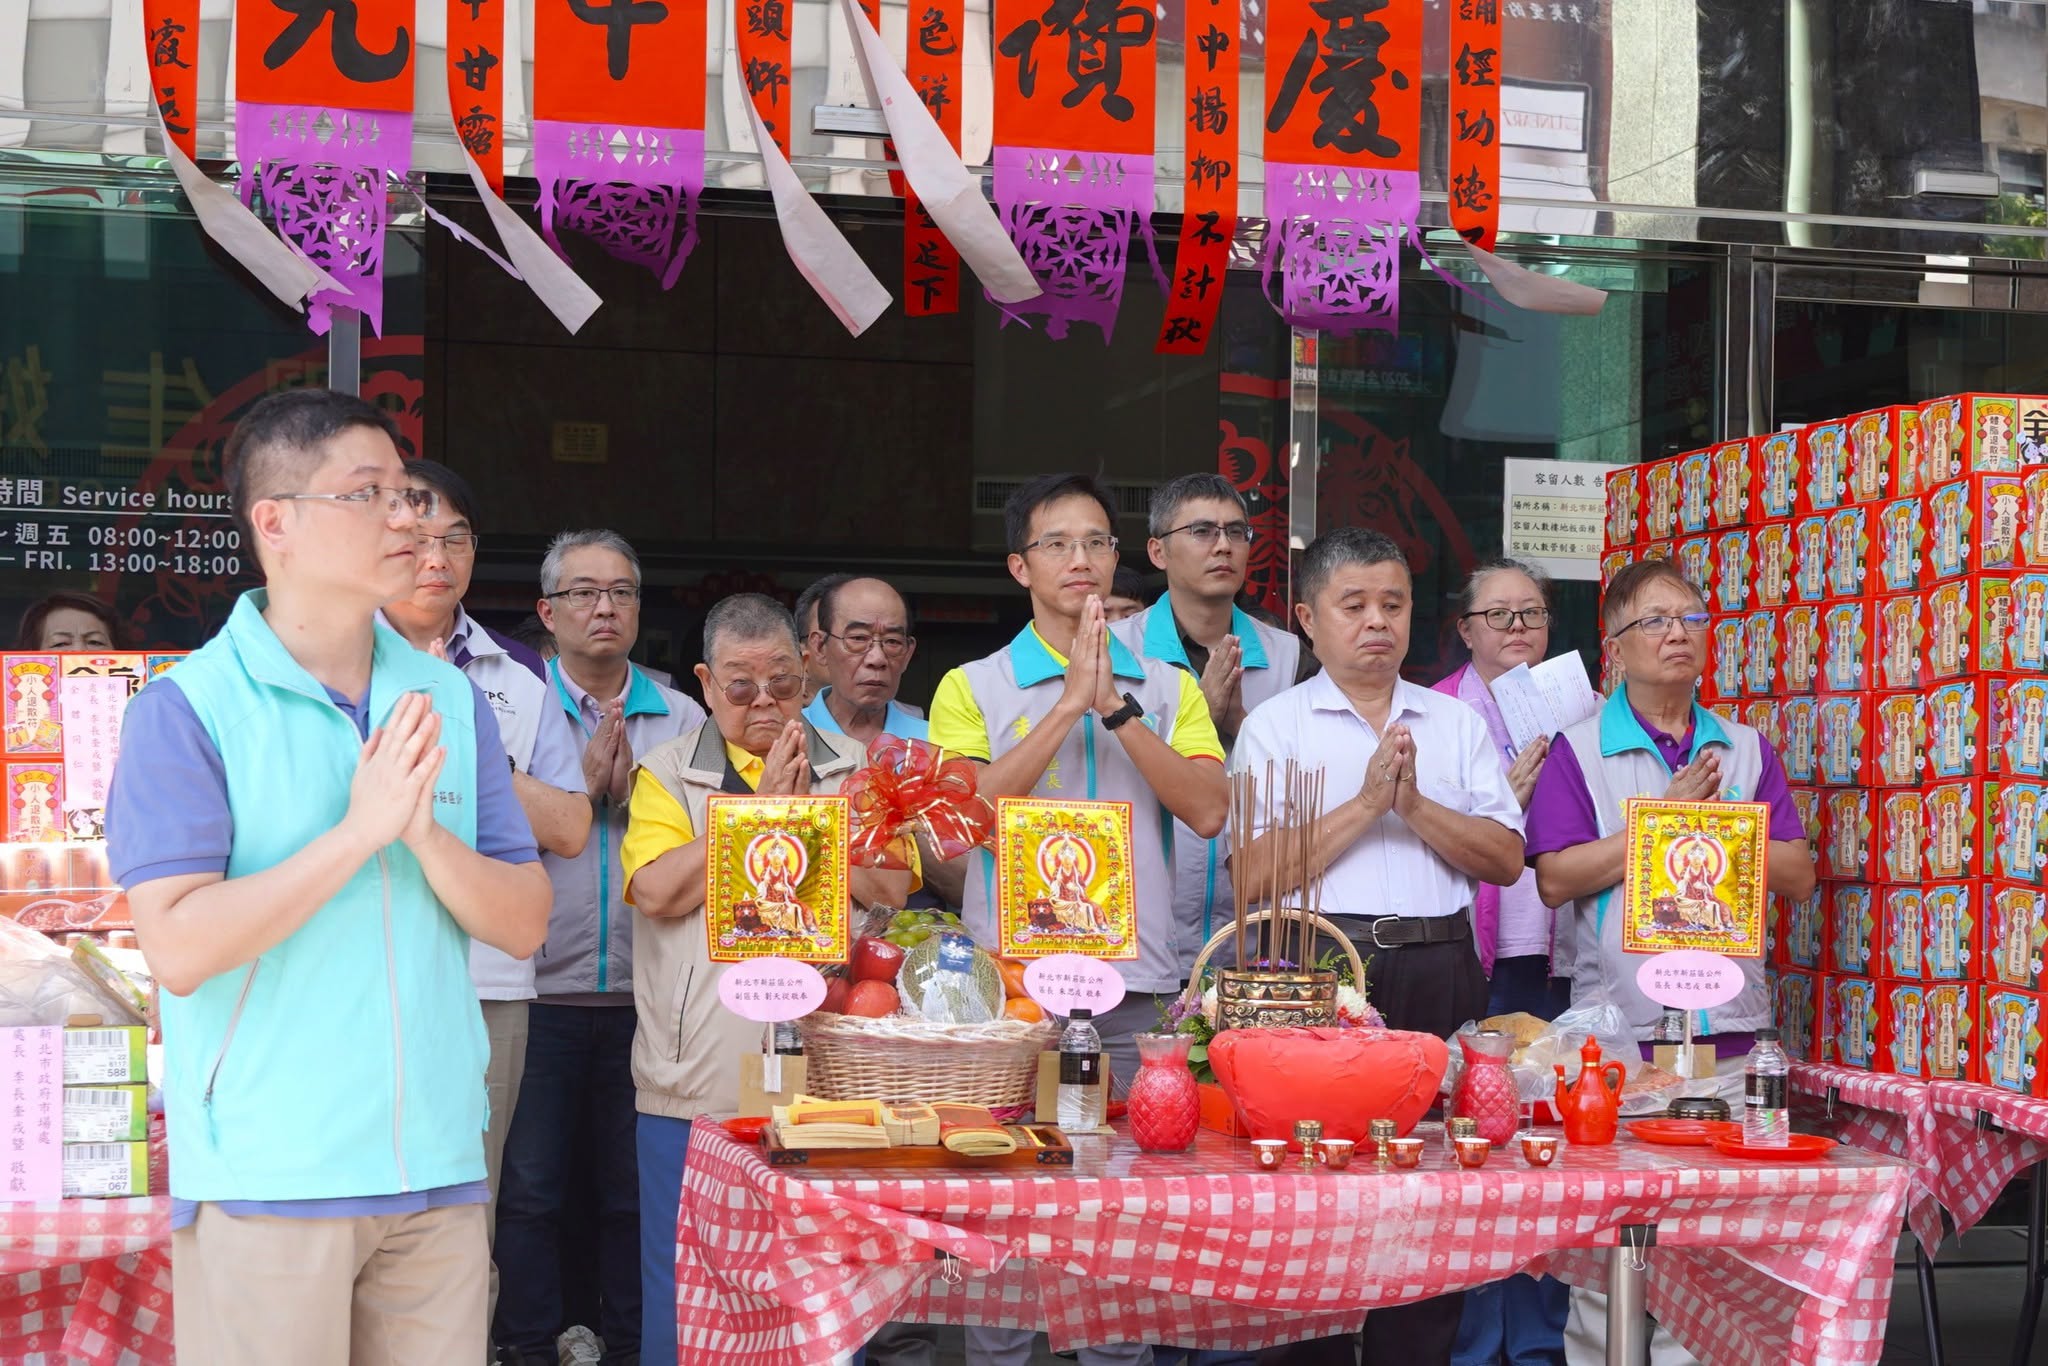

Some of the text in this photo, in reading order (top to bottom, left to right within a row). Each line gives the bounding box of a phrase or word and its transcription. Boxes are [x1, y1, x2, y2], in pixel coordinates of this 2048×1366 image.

[1535, 473, 1585, 487] 容留人數
[63, 486, 156, 508] Service
[88, 526, 241, 549] 08:00~12:00
[24, 550, 241, 575] FRI. 13:00~18:00
[107, 1068, 127, 1077] 588
[108, 1182, 127, 1191] 067
